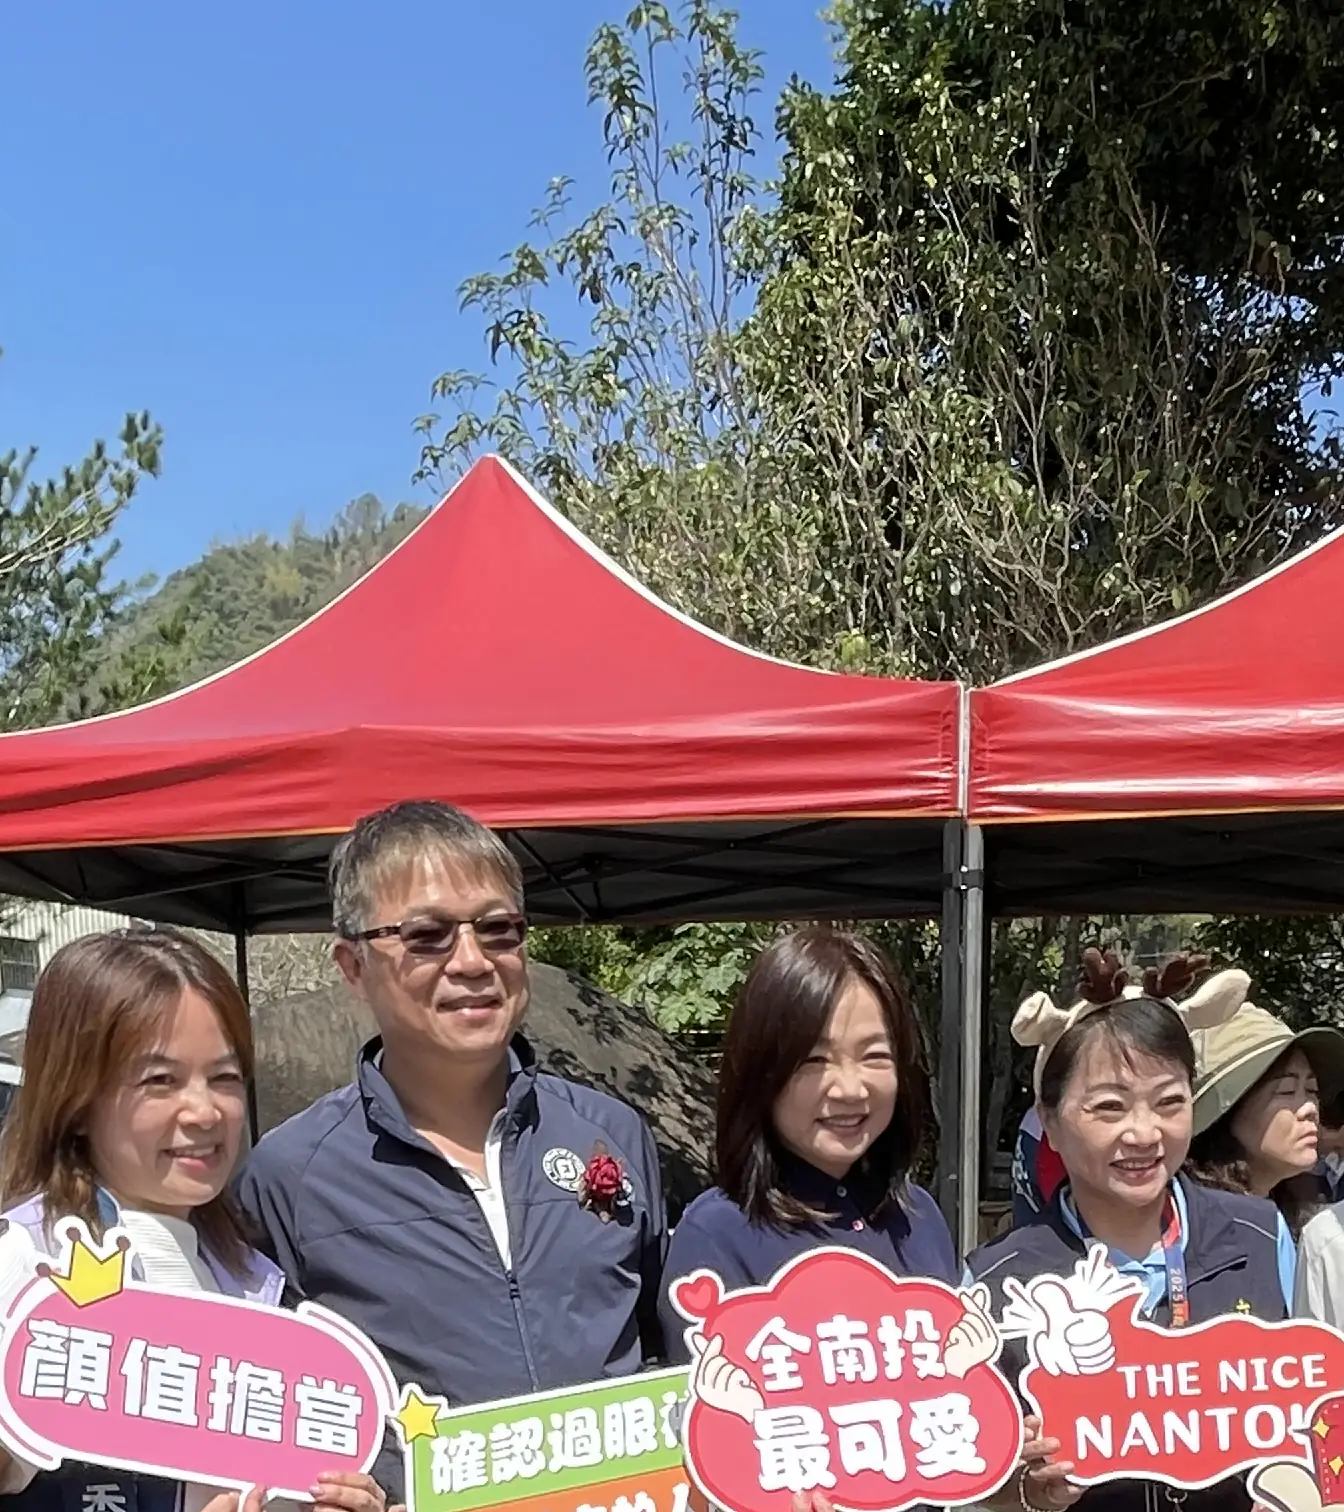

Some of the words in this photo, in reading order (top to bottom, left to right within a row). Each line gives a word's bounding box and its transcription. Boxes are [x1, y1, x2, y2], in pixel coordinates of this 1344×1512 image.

[1170, 1268, 1184, 1301] 2025
[19, 1319, 363, 1456] 顏值擔當
[746, 1309, 946, 1392] 全南投
[1116, 1361, 1201, 1399] THE
[1220, 1353, 1328, 1395] NICE
[753, 1396, 987, 1491] 最可愛
